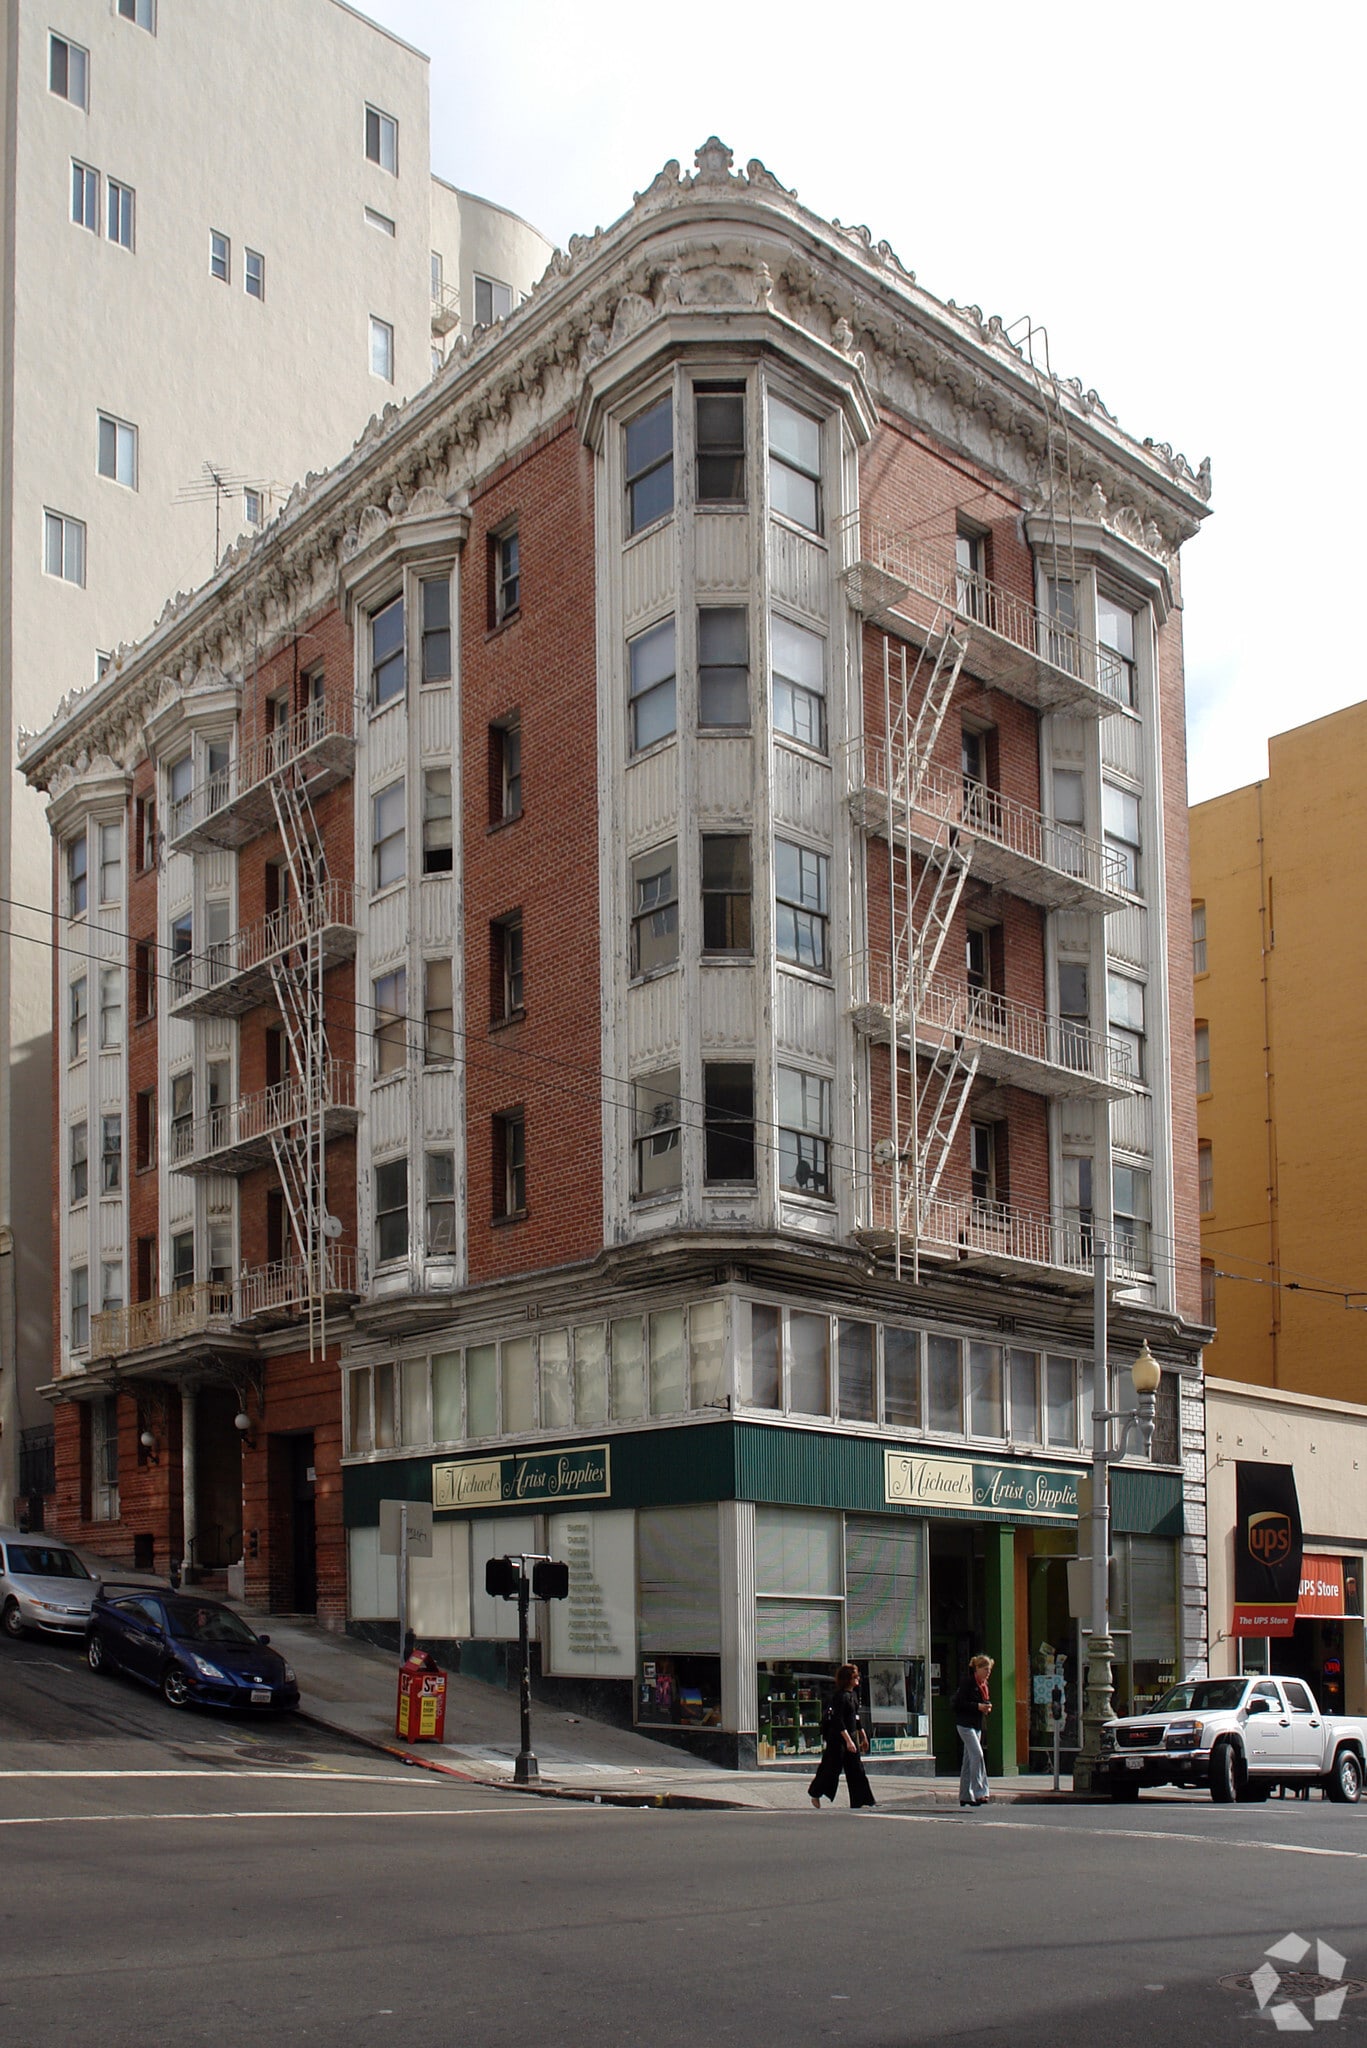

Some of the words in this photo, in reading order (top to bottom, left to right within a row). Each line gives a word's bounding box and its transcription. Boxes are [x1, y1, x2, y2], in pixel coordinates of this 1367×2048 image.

[439, 1467, 500, 1503] Michael's
[503, 1460, 547, 1498] Artist
[548, 1457, 604, 1495] Supplies
[892, 1459, 972, 1498] Michael's
[974, 1470, 1025, 1506] Artist
[1317, 1580, 1339, 1597] Store
[1239, 1616, 1253, 1625] The
[1253, 1616, 1269, 1625] UPS
[1270, 1616, 1289, 1625] Store
